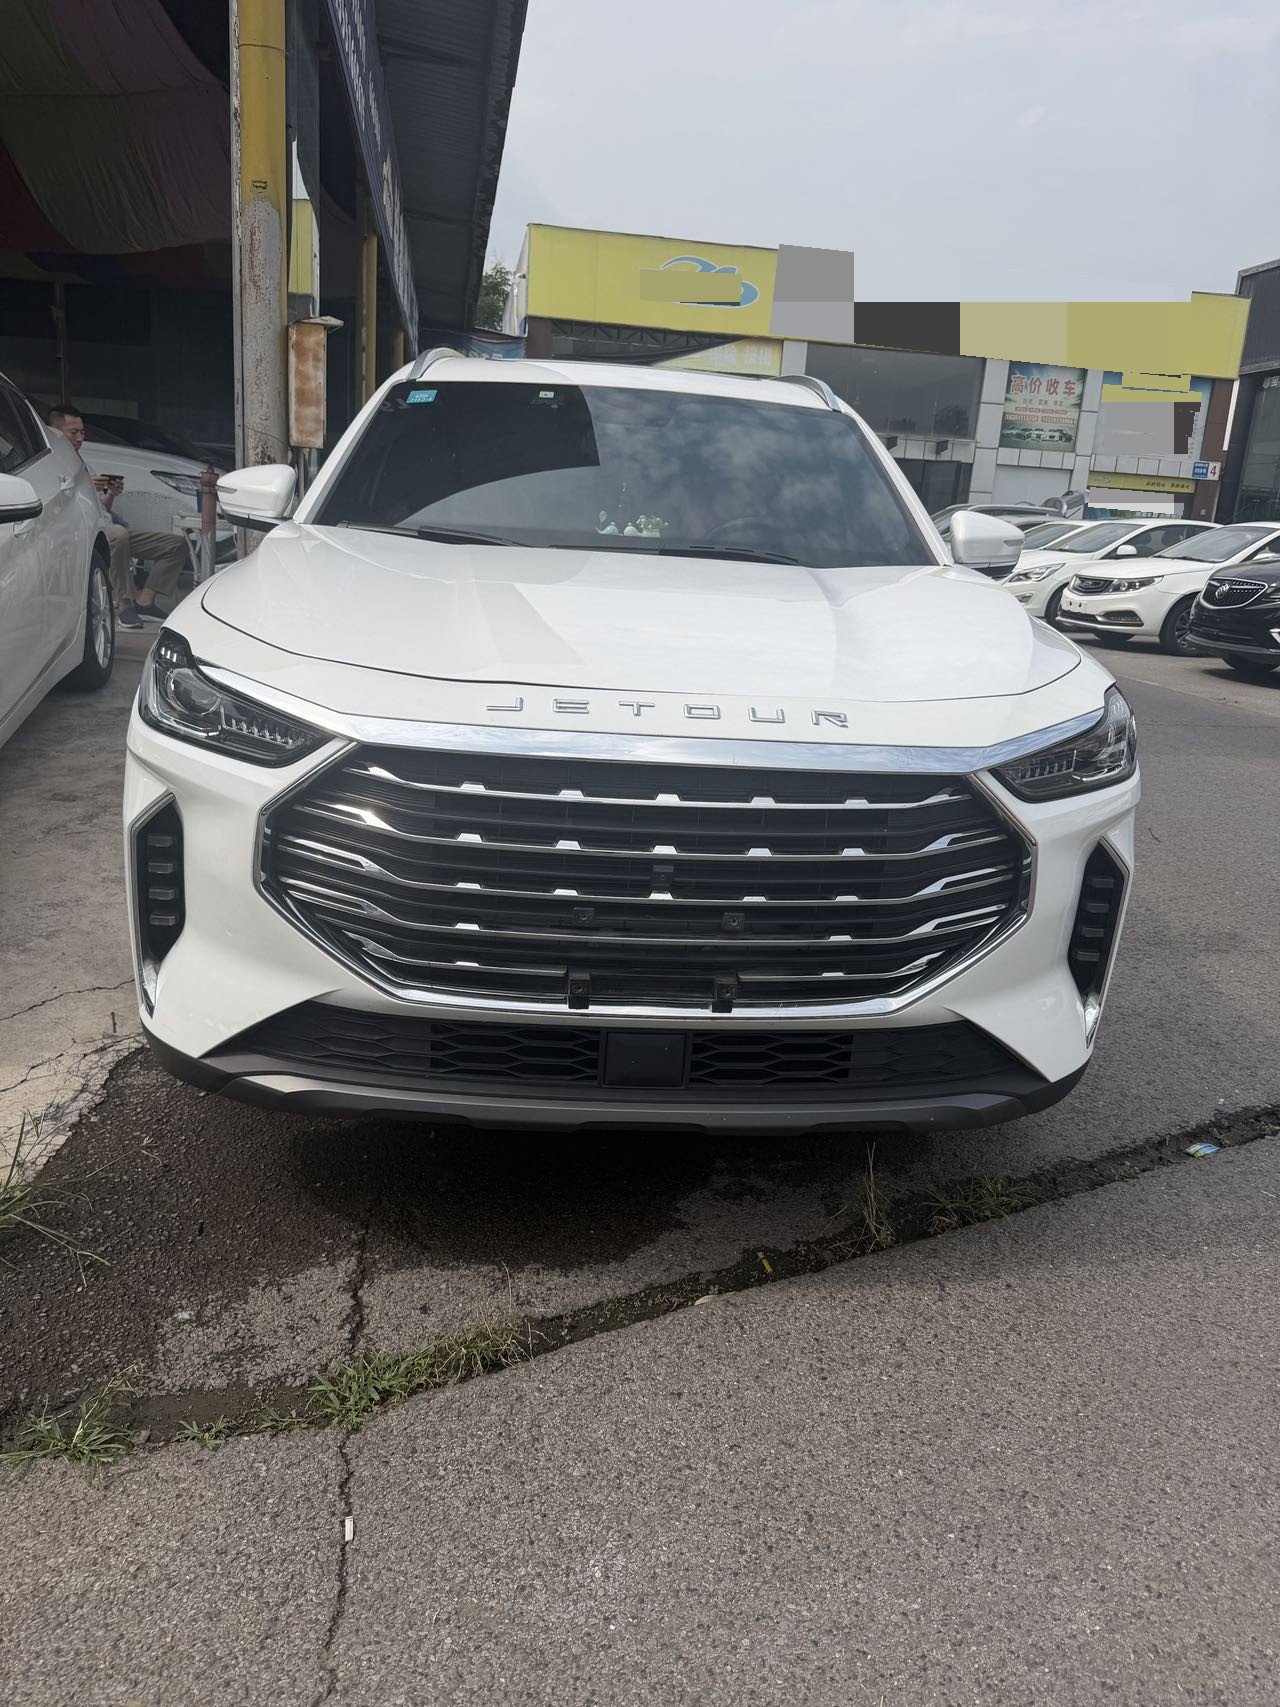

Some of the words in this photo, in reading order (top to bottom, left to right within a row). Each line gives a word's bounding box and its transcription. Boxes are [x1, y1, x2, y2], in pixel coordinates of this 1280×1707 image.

[1011, 375, 1077, 397] 高价收车
[1210, 465, 1217, 477] 4
[486, 697, 849, 729] JETOUR
